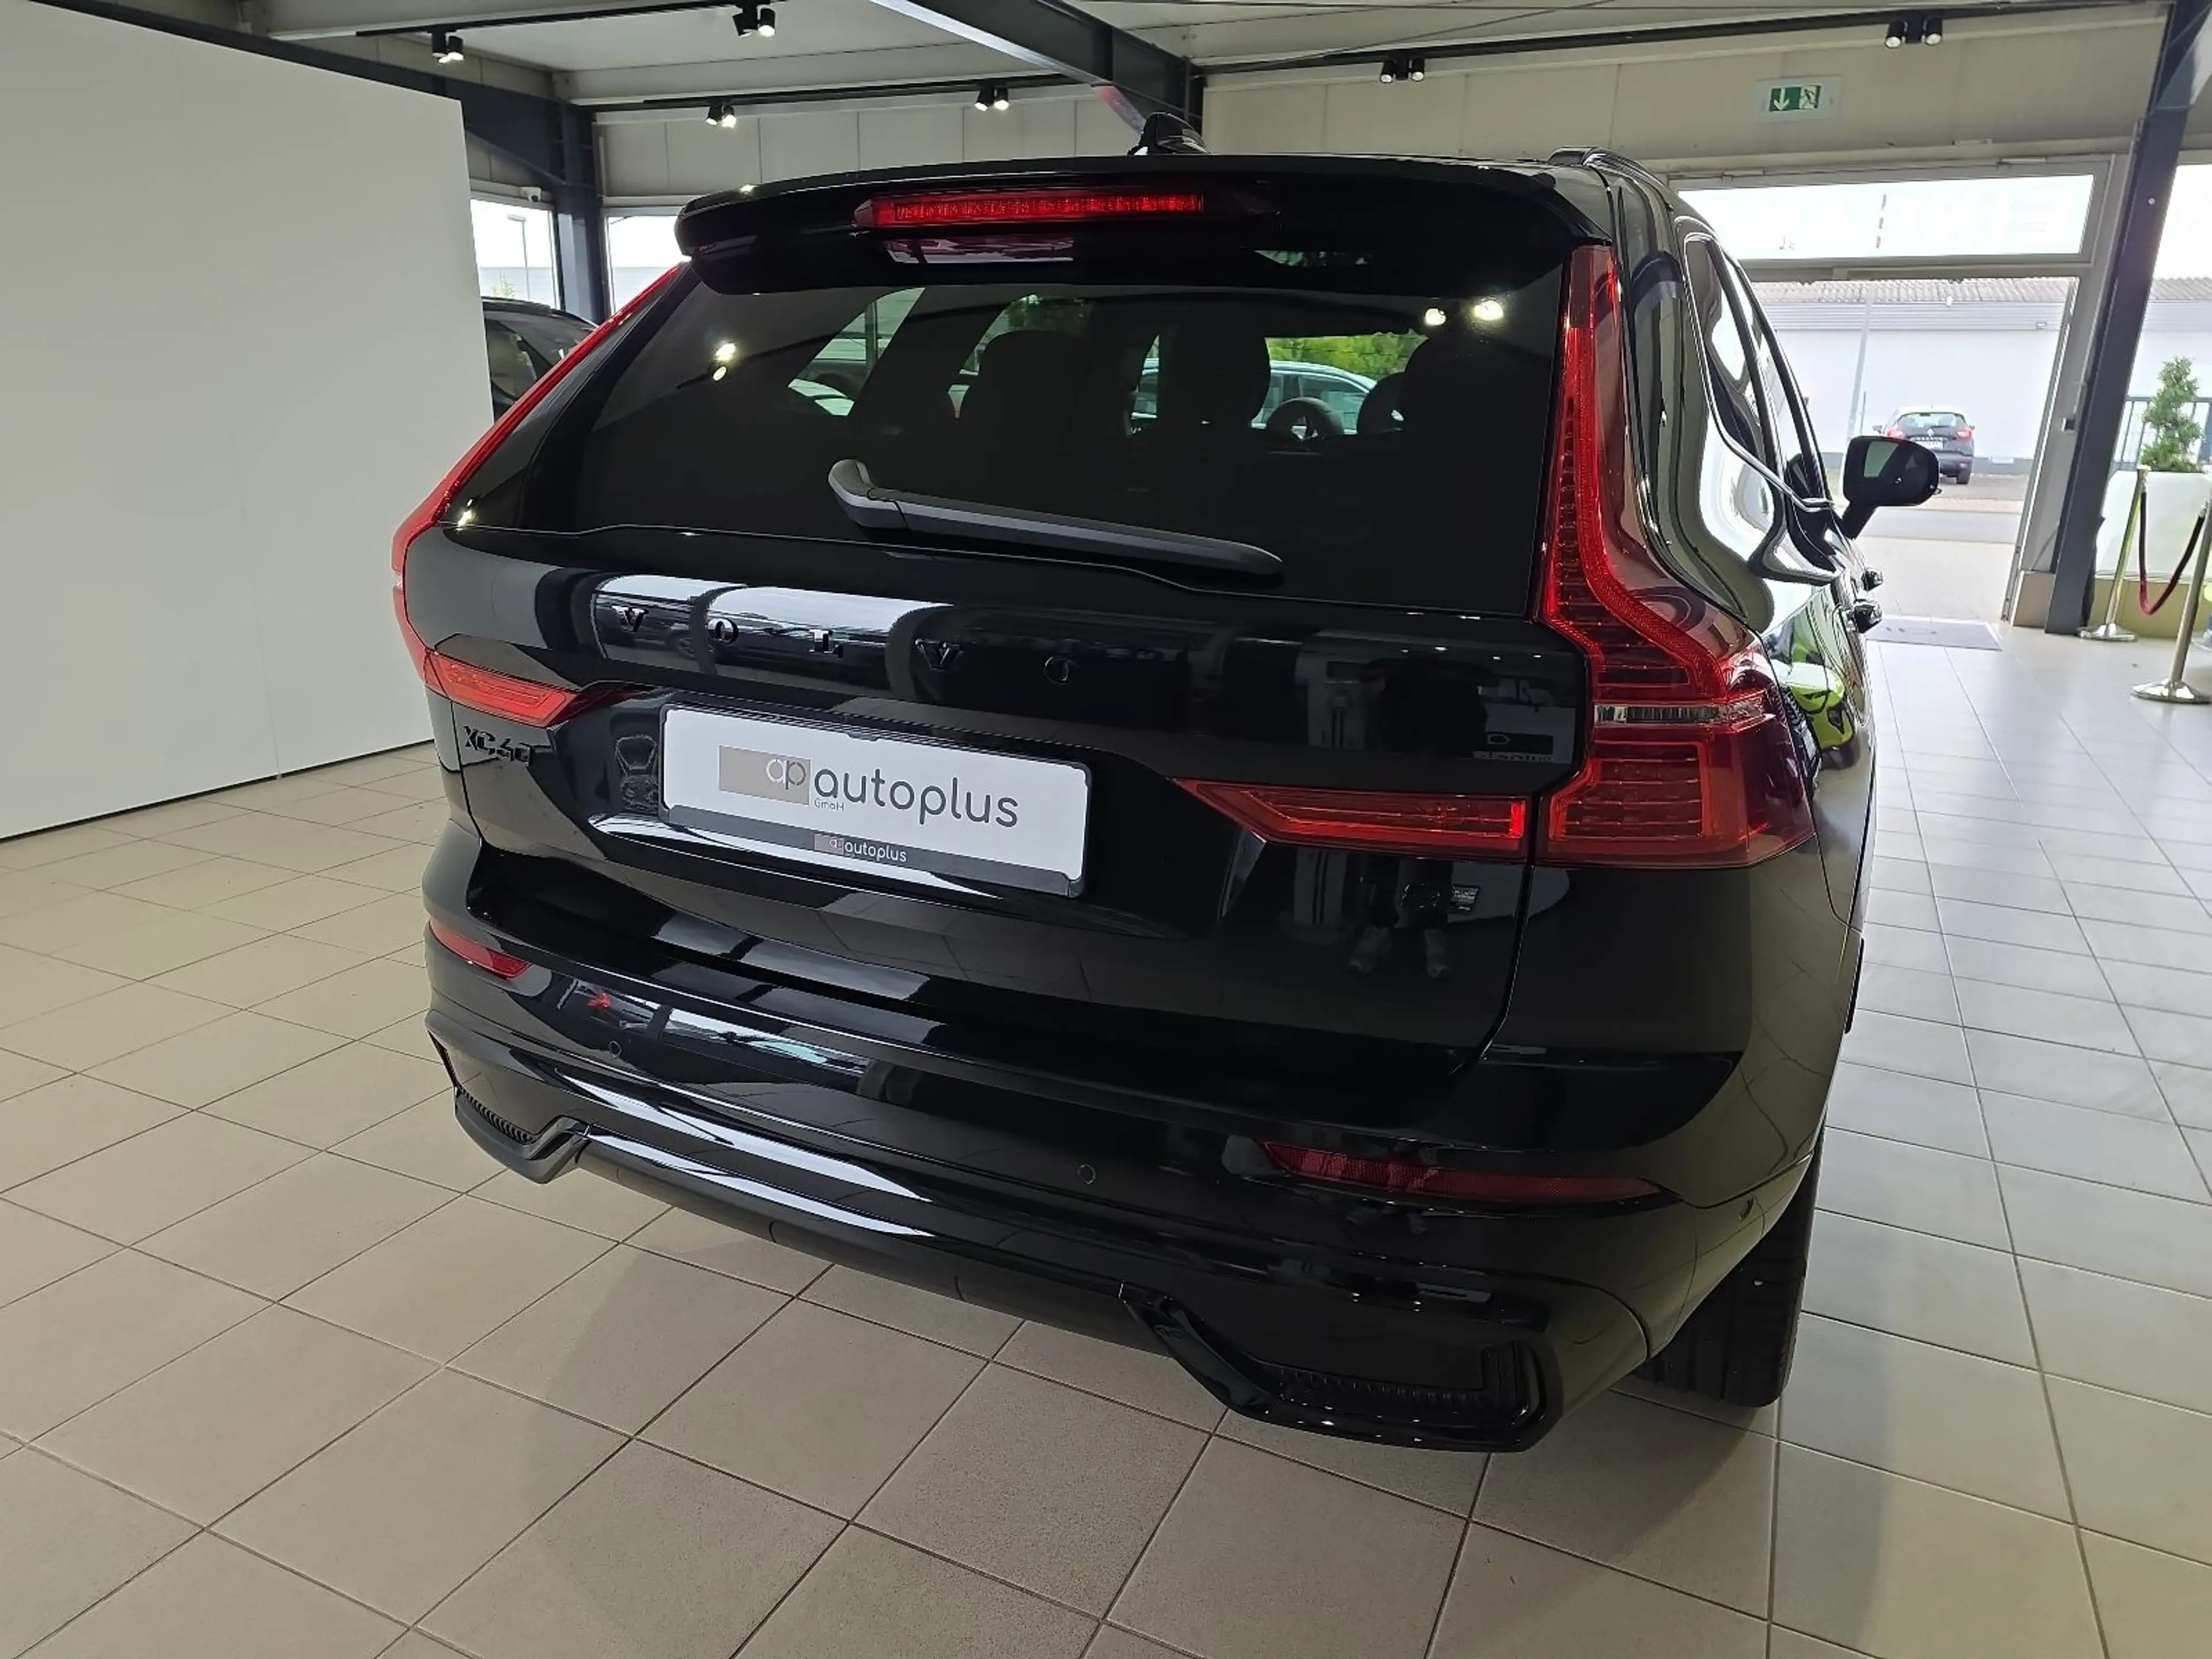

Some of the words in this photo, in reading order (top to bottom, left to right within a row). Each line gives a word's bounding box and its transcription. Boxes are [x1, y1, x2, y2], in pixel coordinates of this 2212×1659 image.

[610, 604, 1070, 685] VOLVO
[463, 725, 533, 767] XC60
[813, 768, 1018, 828] autoplus
[844, 841, 907, 862] autoplus
